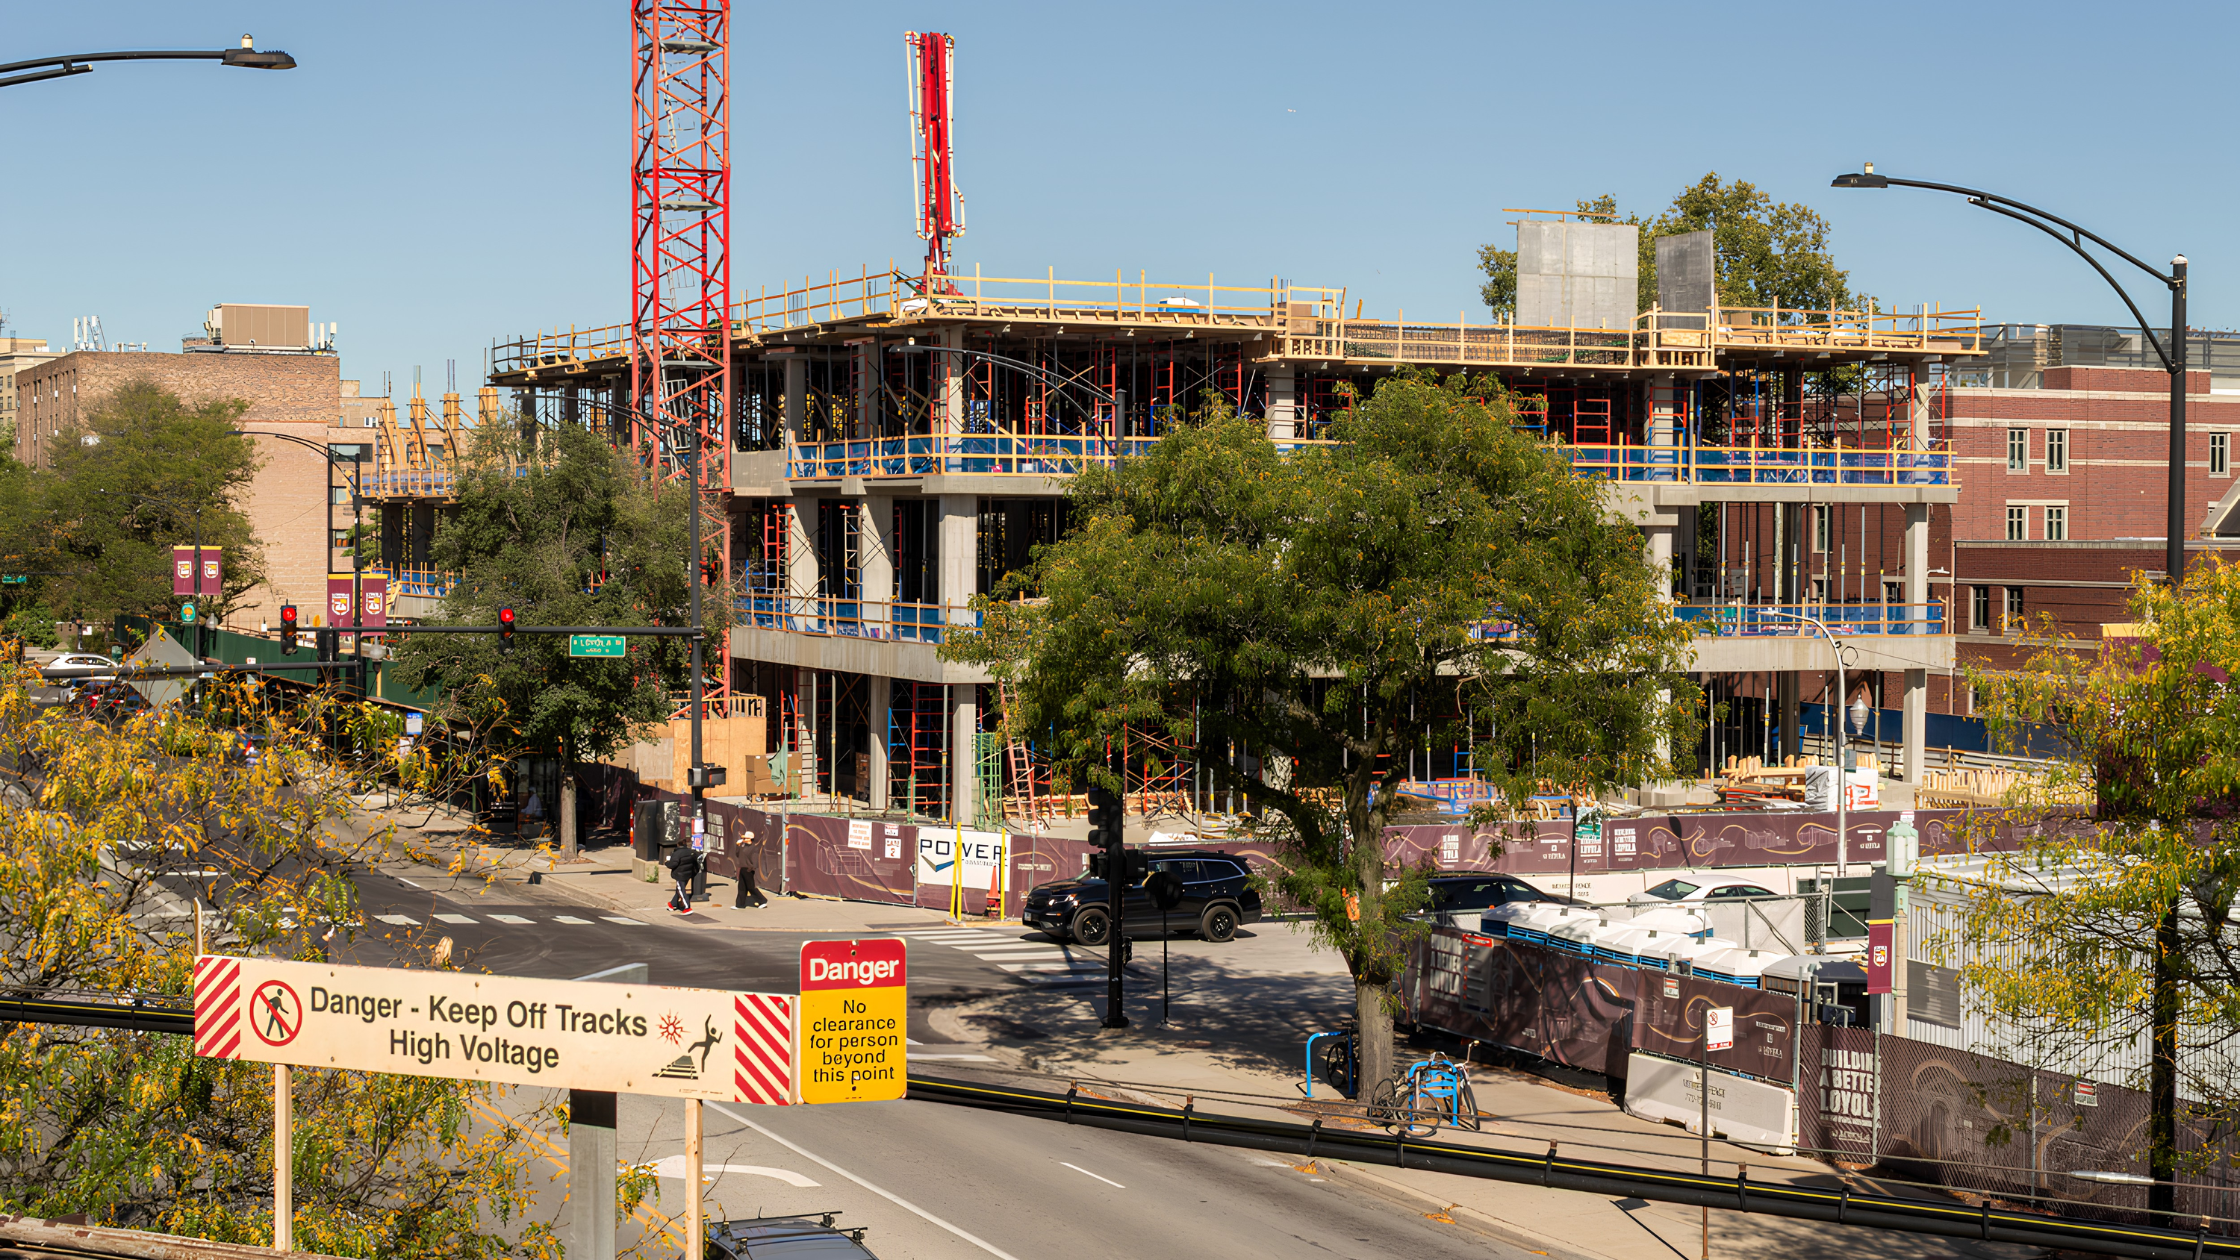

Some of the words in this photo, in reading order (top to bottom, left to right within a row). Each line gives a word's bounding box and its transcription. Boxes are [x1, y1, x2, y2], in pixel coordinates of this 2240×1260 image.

[920, 838, 1007, 861] POWER
[809, 958, 900, 985] Danger
[310, 986, 402, 1023] Danger
[429, 995, 497, 1032] Keep
[506, 1000, 547, 1029] Off
[555, 1003, 647, 1037] Tracks
[843, 999, 867, 1014] No
[813, 1017, 896, 1032] clearance
[390, 1028, 450, 1064] High
[459, 1034, 559, 1074] Voltage
[810, 1034, 833, 1049] for
[839, 1034, 898, 1051] person
[823, 1049, 885, 1068] beyond
[1821, 1047, 1881, 1074] BUILDIN
[813, 1067, 844, 1082] this
[851, 1066, 895, 1085] point
[1819, 1067, 1829, 1087] A
[1831, 1069, 1881, 1095] BETTE
[1819, 1088, 1881, 1120] LOYOL
